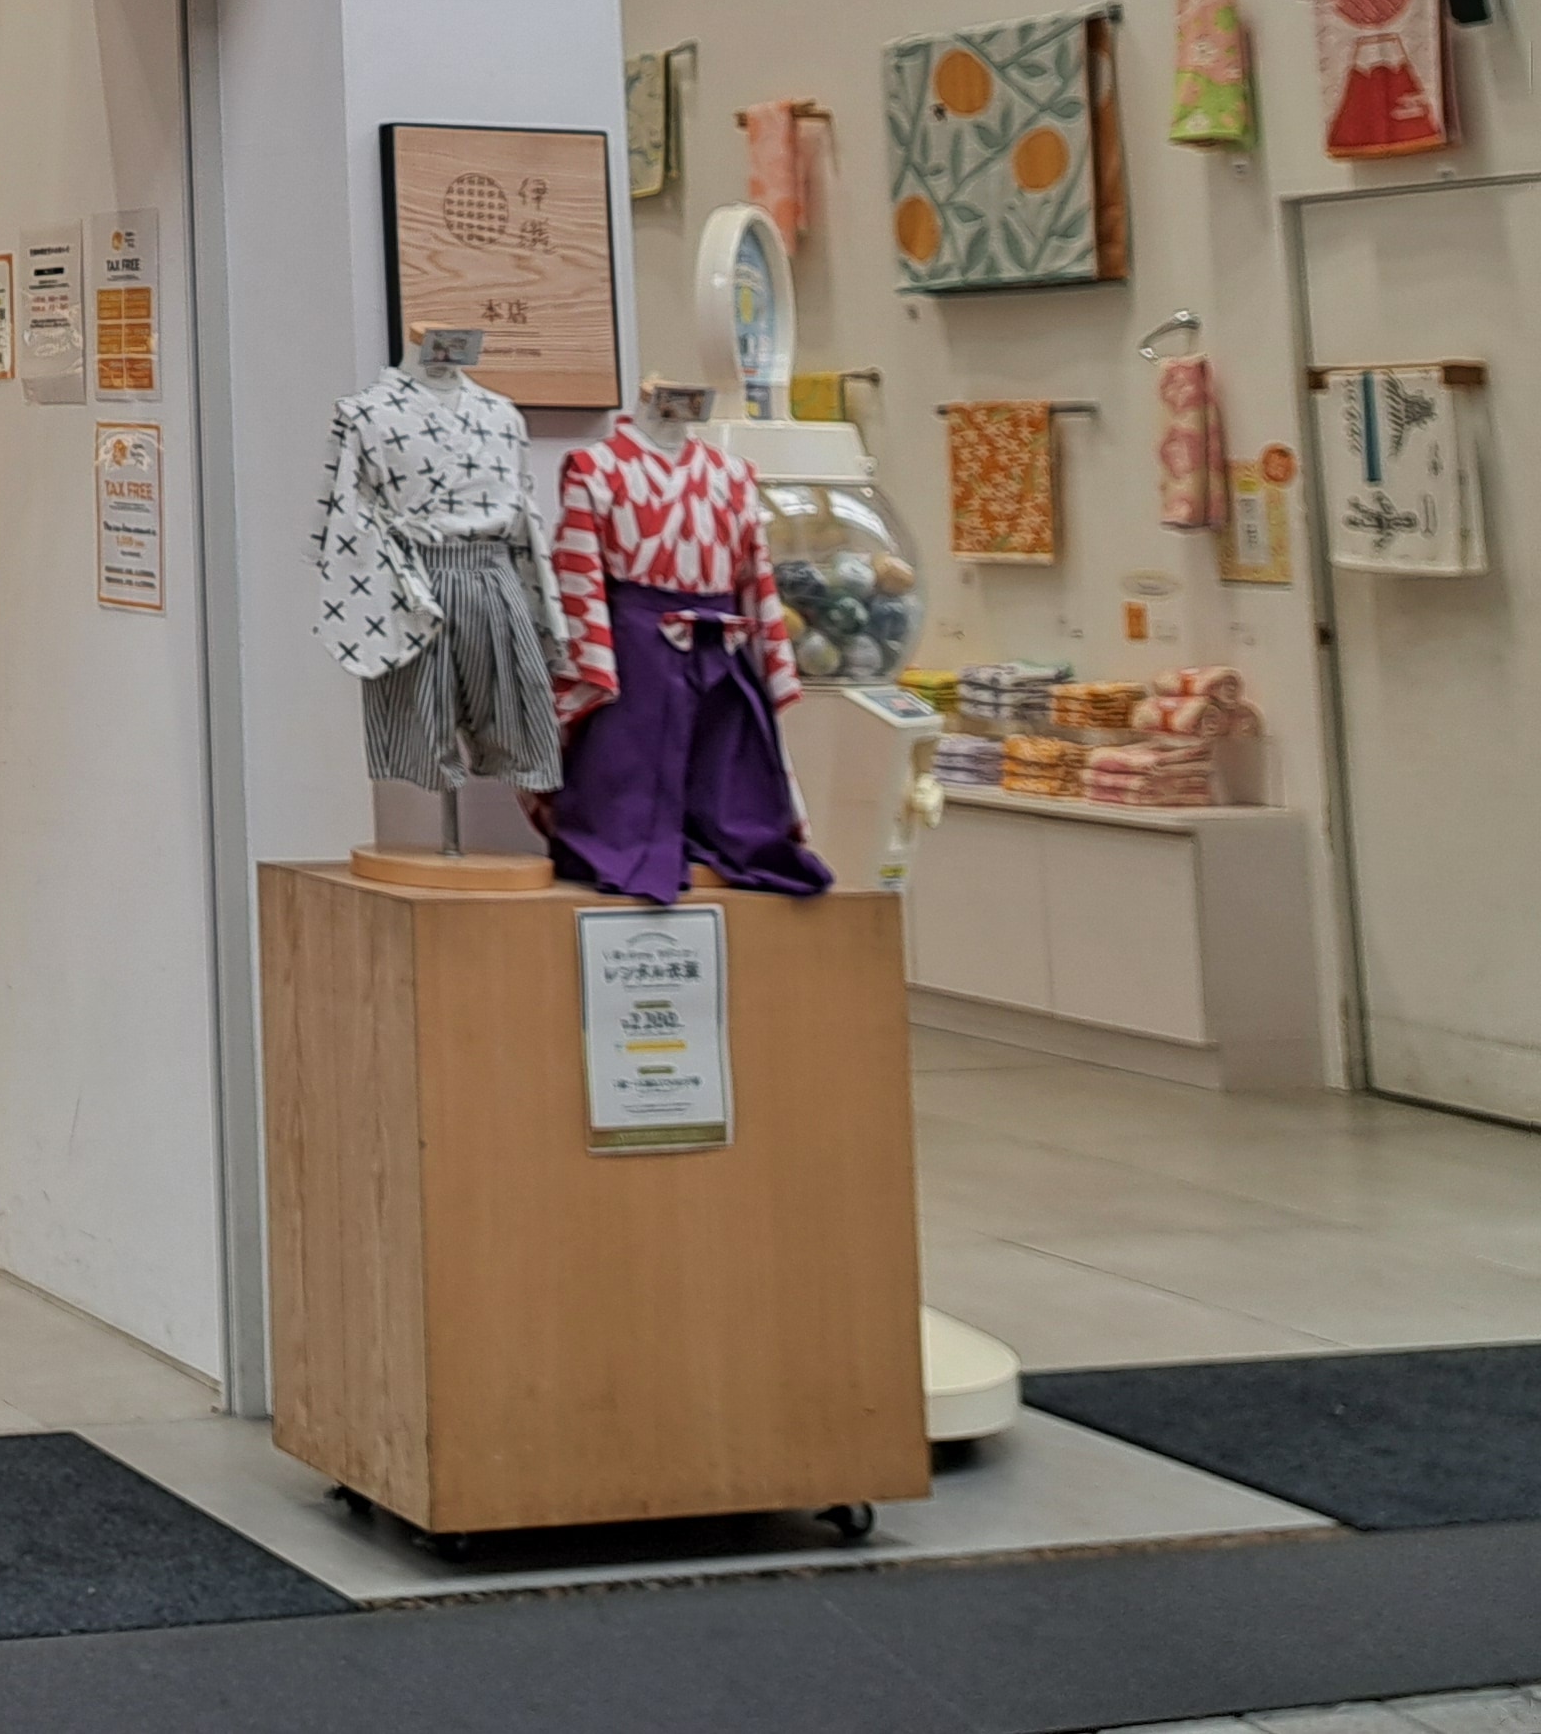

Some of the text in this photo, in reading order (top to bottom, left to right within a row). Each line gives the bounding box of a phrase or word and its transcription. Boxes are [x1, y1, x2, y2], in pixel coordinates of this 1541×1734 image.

[481, 299, 529, 324] 本店
[105, 480, 154, 501] TAX FREE
